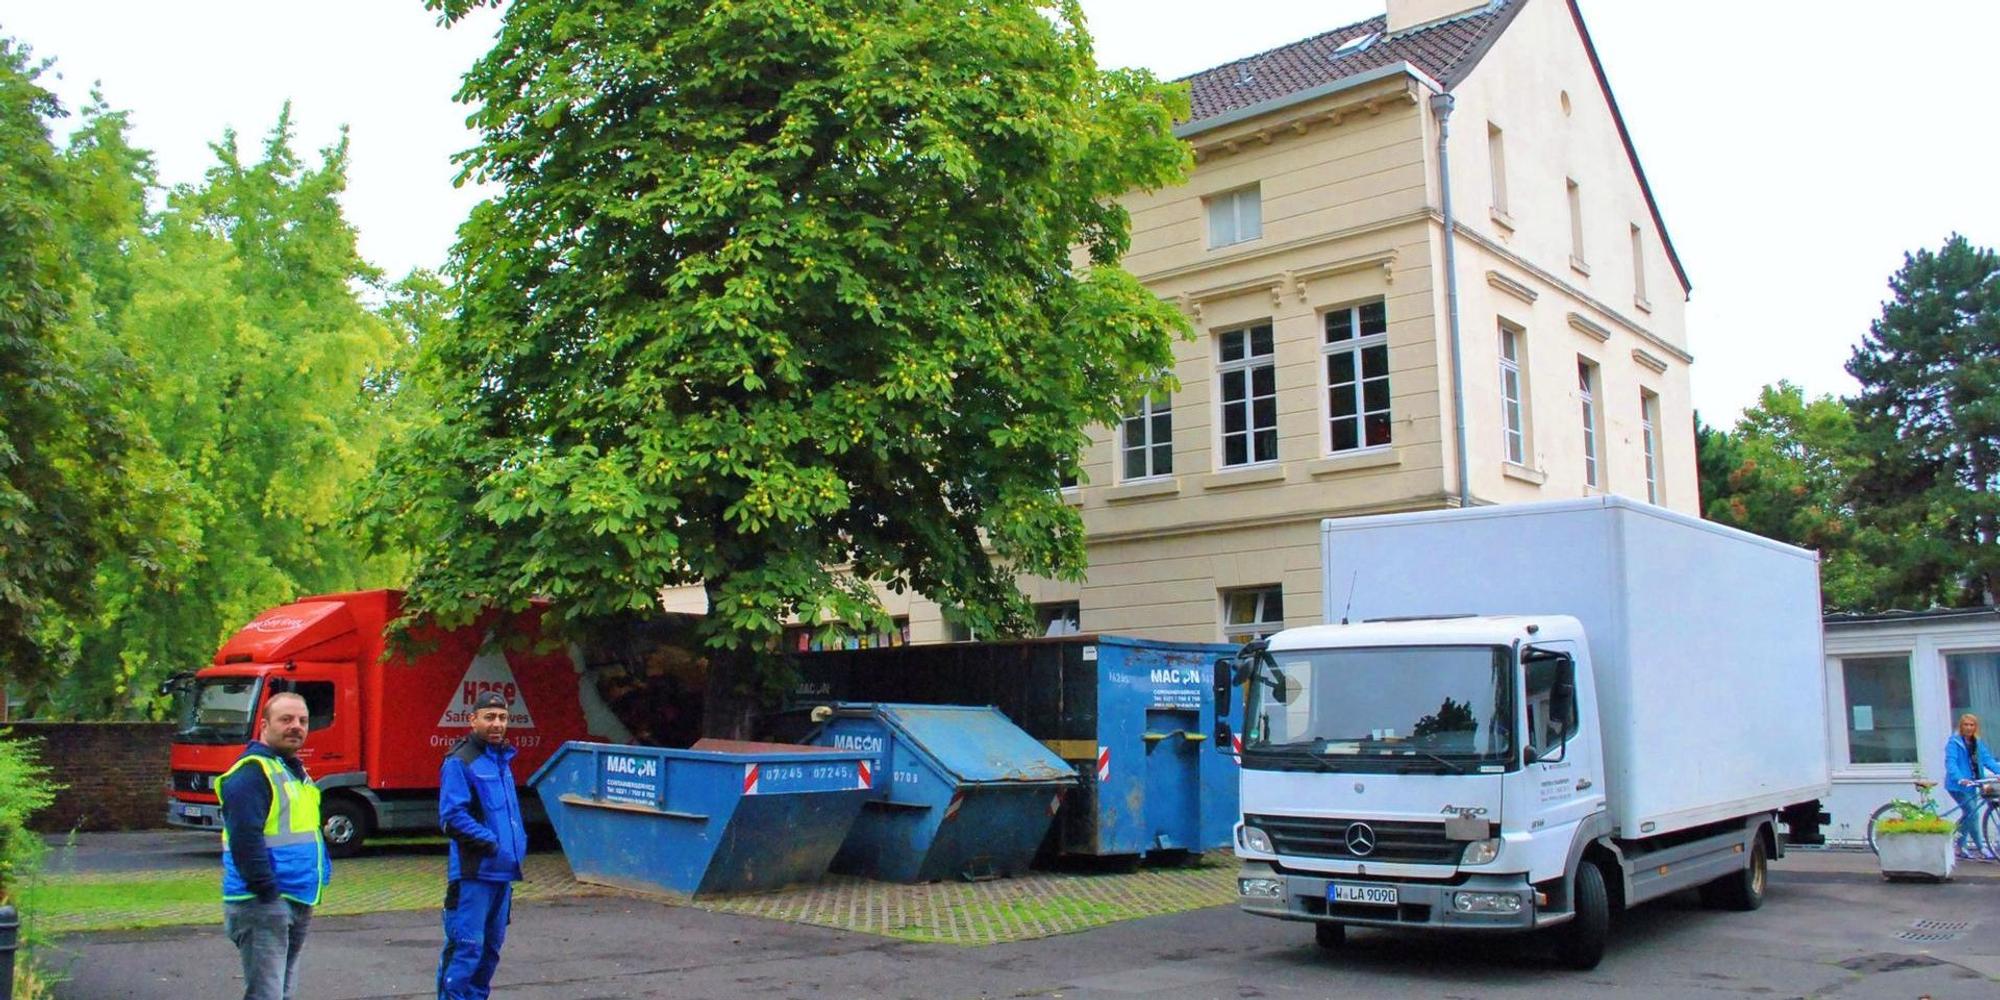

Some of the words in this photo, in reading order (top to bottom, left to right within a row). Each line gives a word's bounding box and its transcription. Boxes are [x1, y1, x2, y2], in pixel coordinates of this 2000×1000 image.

[516, 735, 541, 747] 1937
[607, 755, 656, 777] MACON
[766, 768, 803, 780] 07245
[1350, 888, 1364, 900] LA
[1366, 889, 1395, 902] 9090
